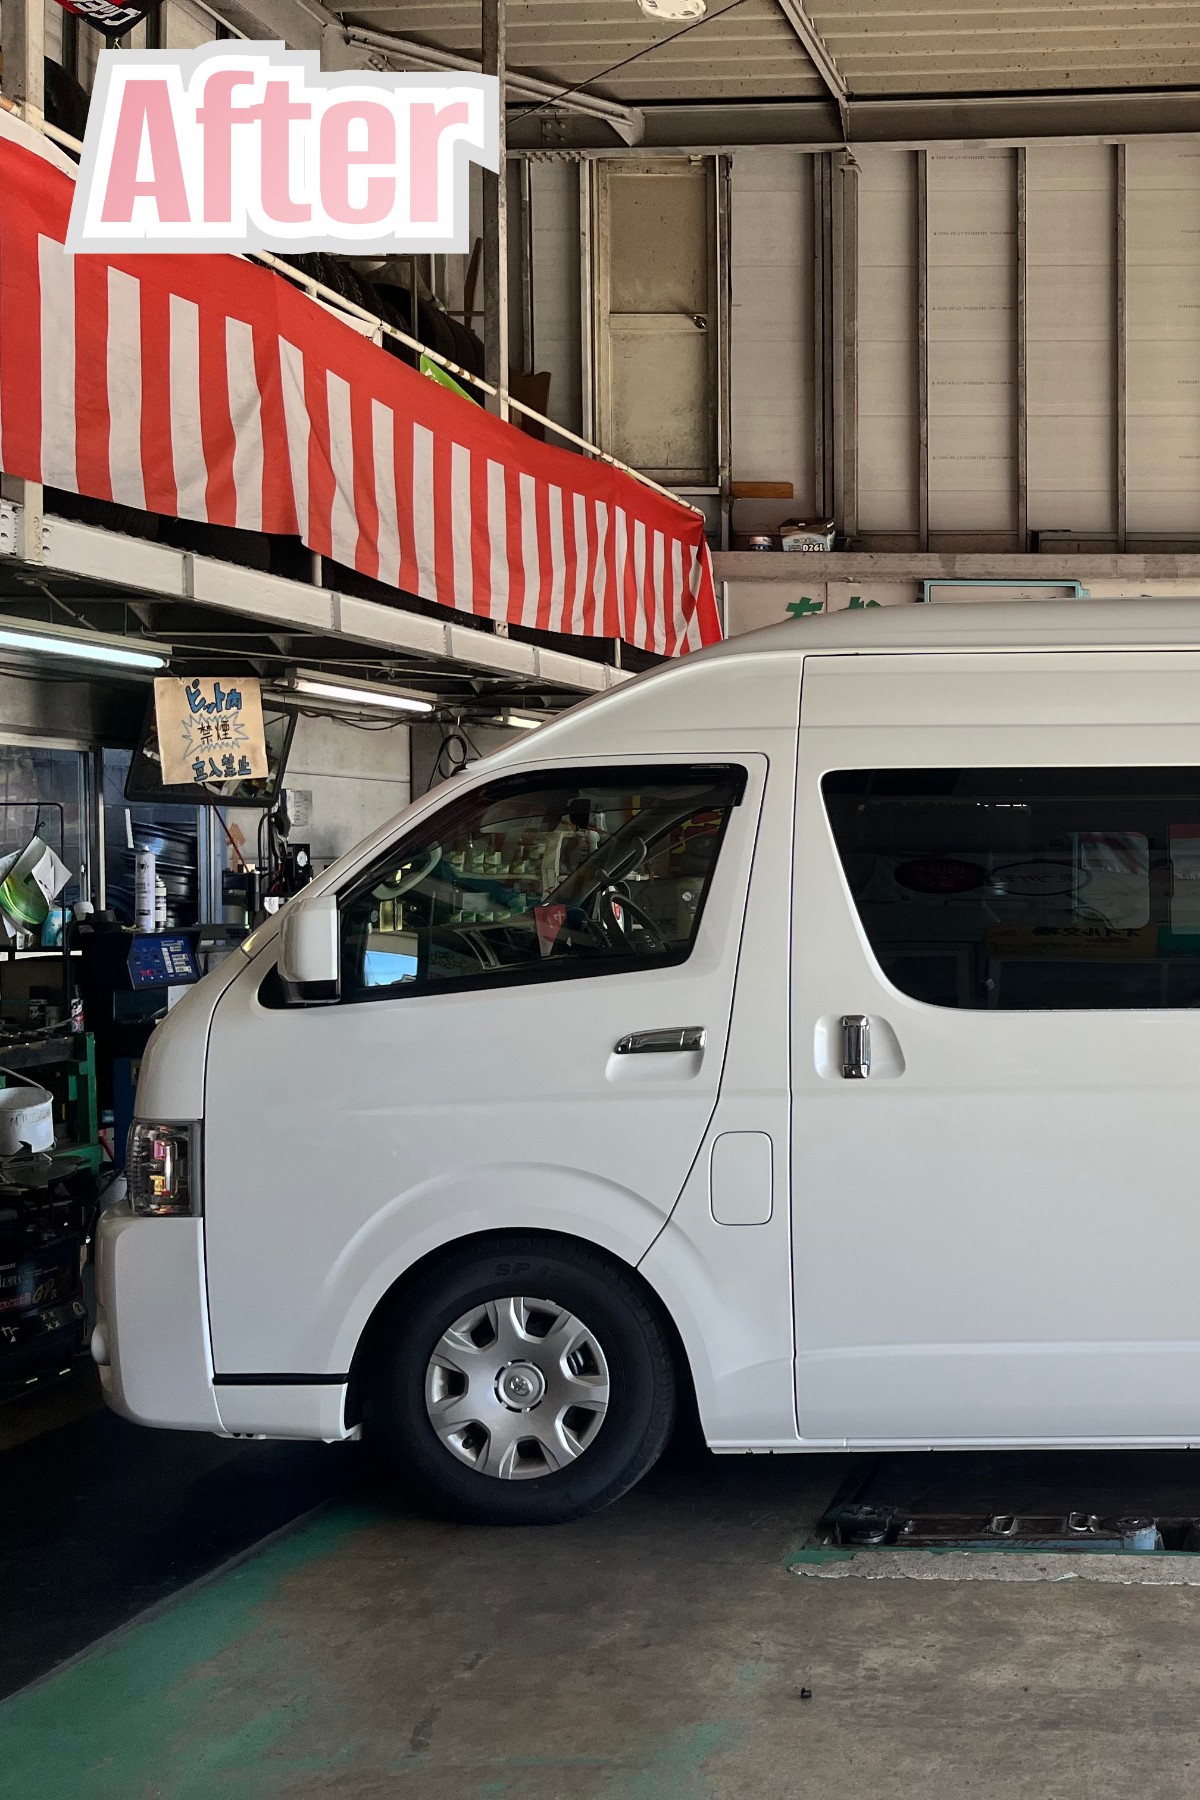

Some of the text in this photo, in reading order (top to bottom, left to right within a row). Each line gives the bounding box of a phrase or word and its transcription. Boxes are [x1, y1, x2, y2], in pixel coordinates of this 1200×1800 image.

[802, 543, 824, 552] D26L
[185, 678, 243, 714] ピット内
[197, 720, 232, 746] 禁煙
[192, 753, 251, 782] 立入禁止
